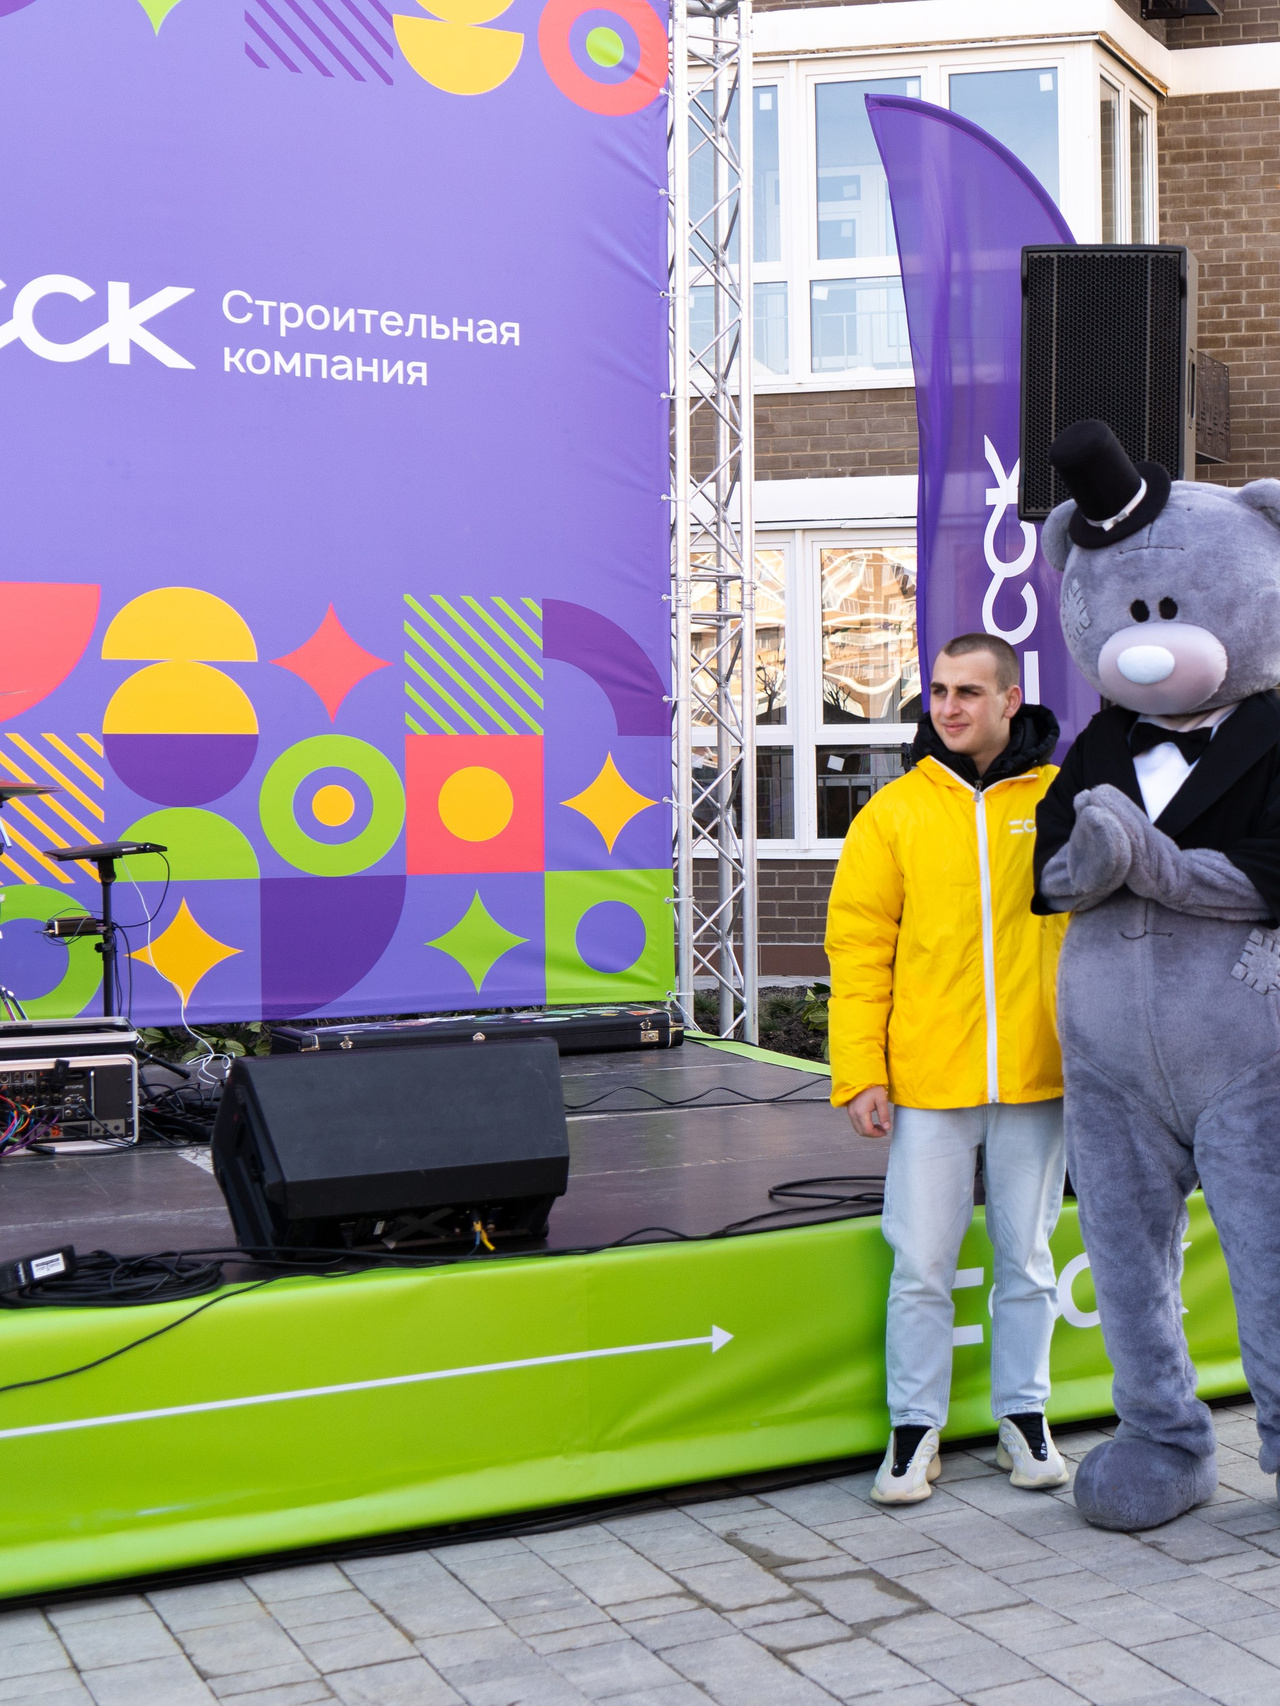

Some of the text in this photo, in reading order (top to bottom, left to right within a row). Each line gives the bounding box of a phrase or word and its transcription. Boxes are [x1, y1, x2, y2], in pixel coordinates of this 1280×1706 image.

[0, 273, 197, 370] СК
[221, 288, 521, 347] Строительная
[222, 346, 429, 387] компания
